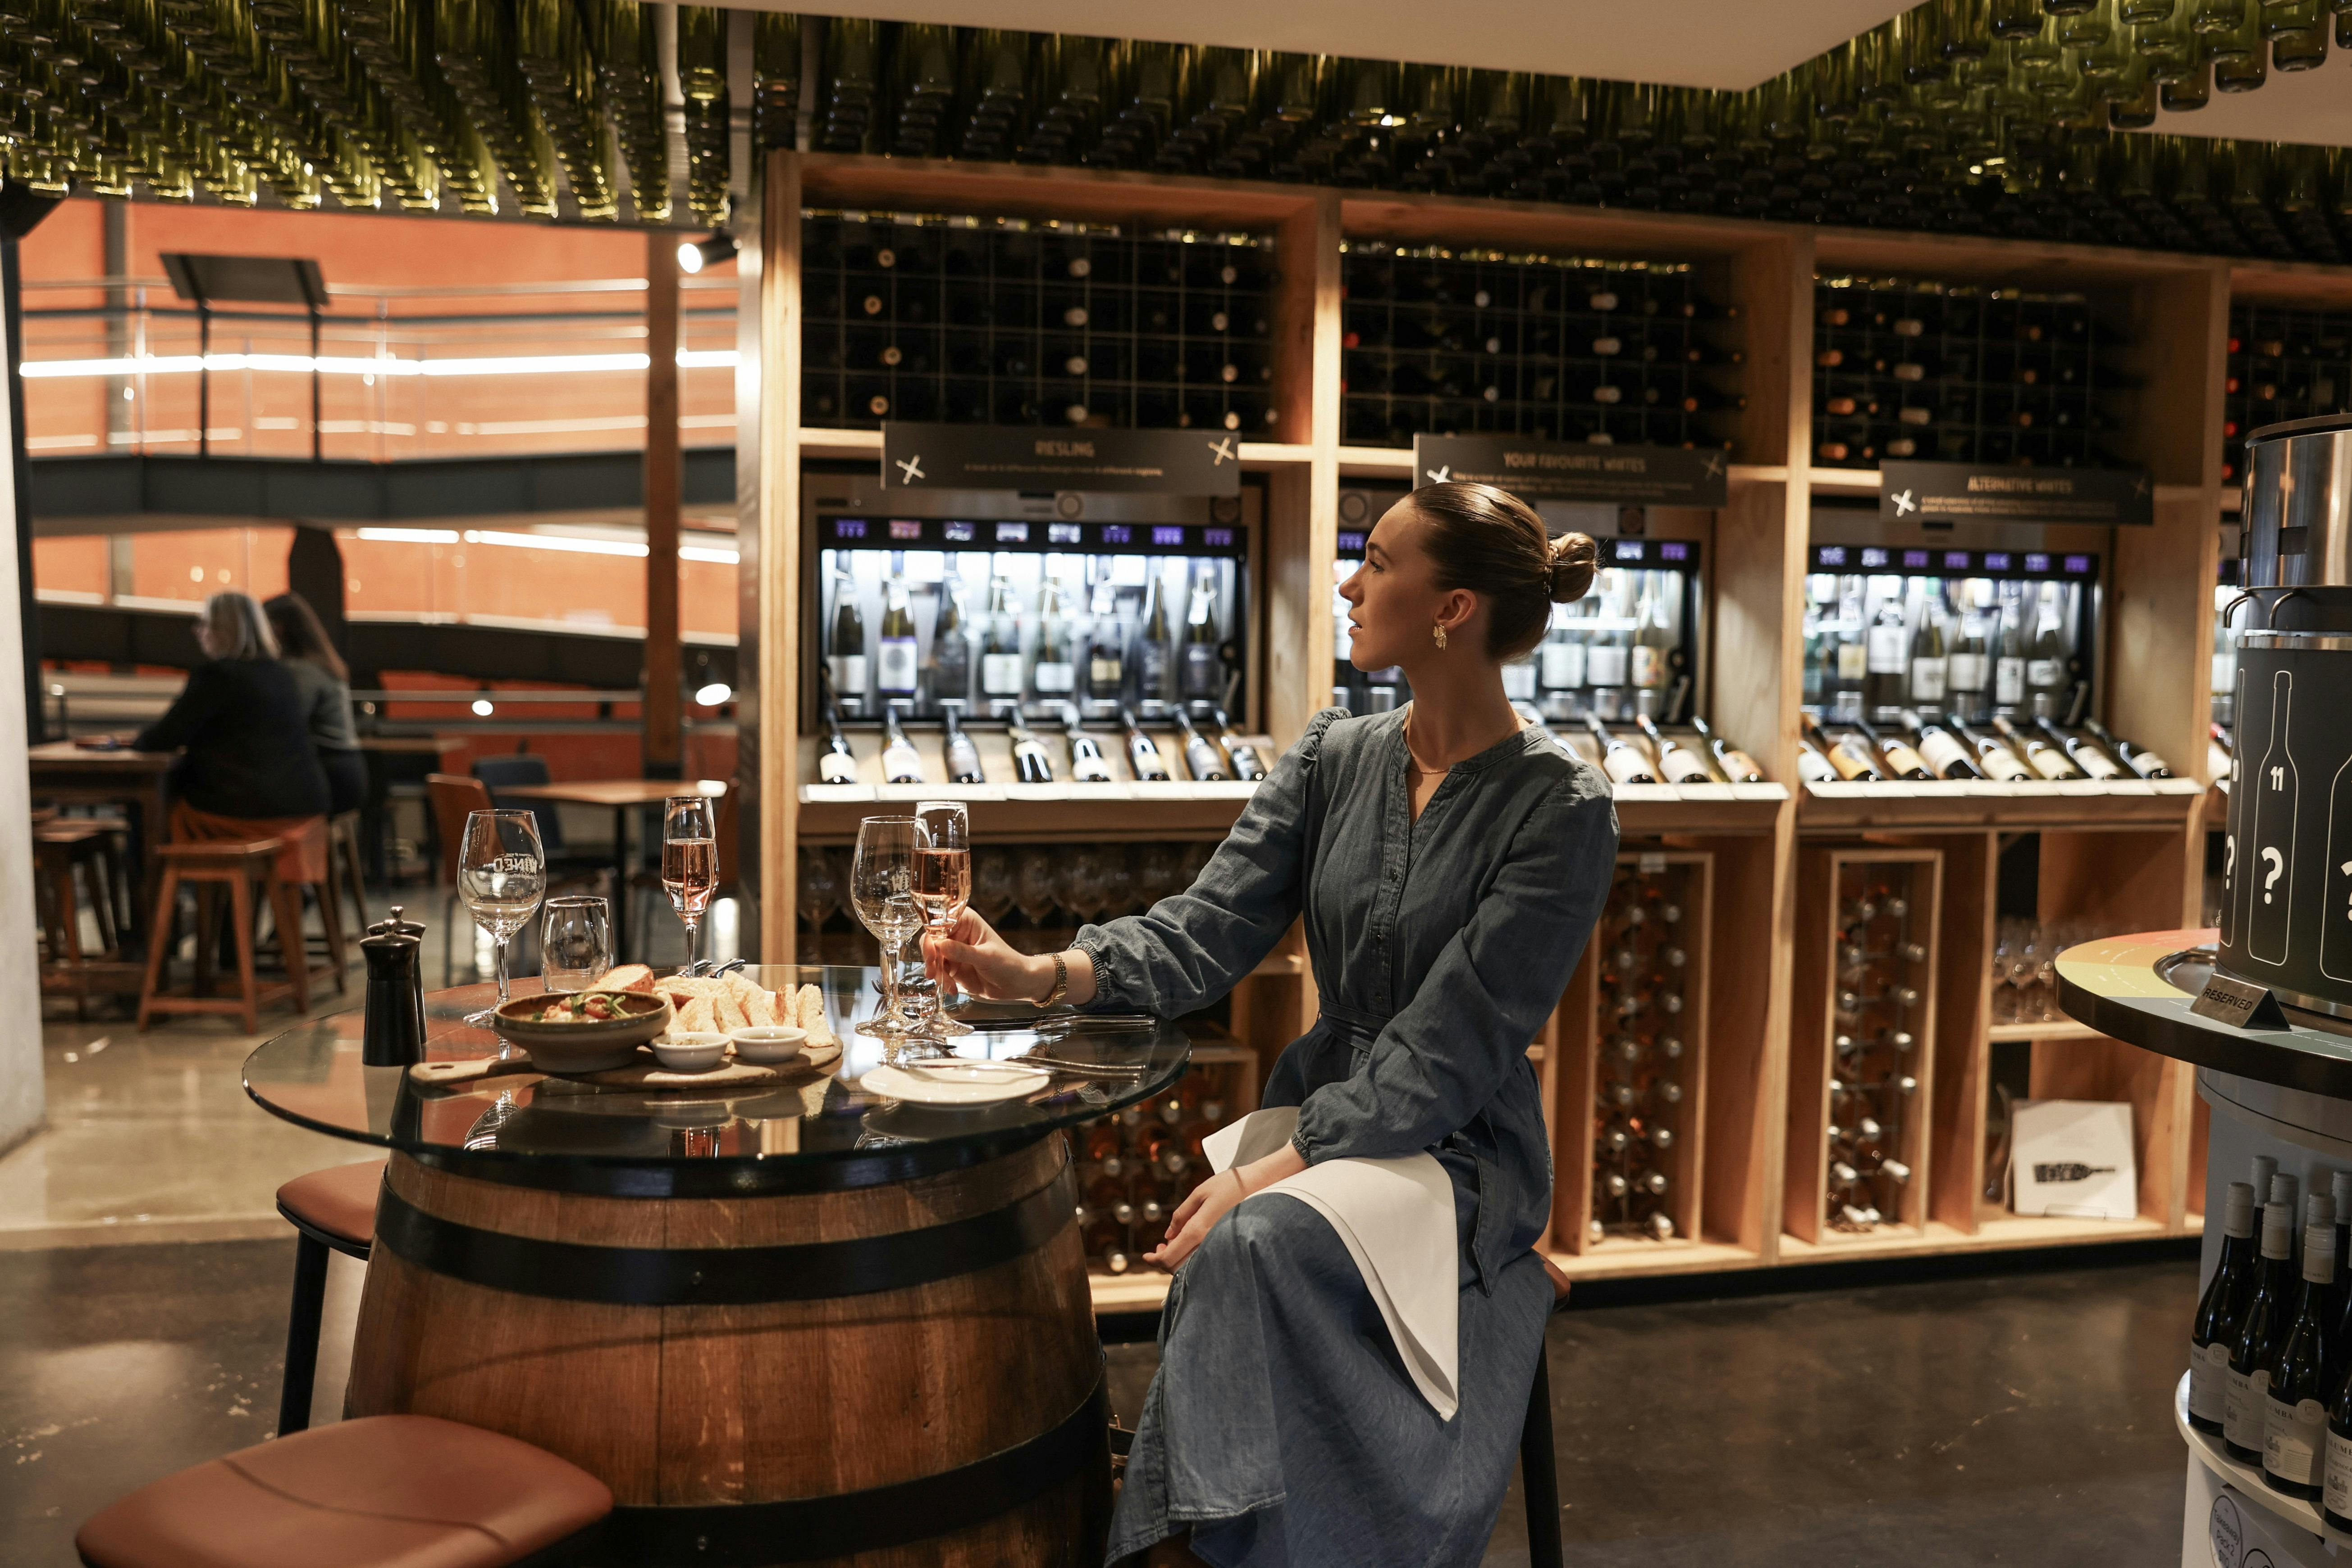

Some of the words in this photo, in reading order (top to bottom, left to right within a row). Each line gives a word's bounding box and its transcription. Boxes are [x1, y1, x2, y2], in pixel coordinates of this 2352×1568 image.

[1035, 440, 1095, 457] RIESLING
[1503, 452, 1536, 468] YOUR
[1538, 453, 1600, 471] FAVOURITE
[1967, 475, 2033, 493] ALTERNATIVE
[2270, 766, 2284, 791] 11
[2202, 988, 2252, 1010] RESERVED
